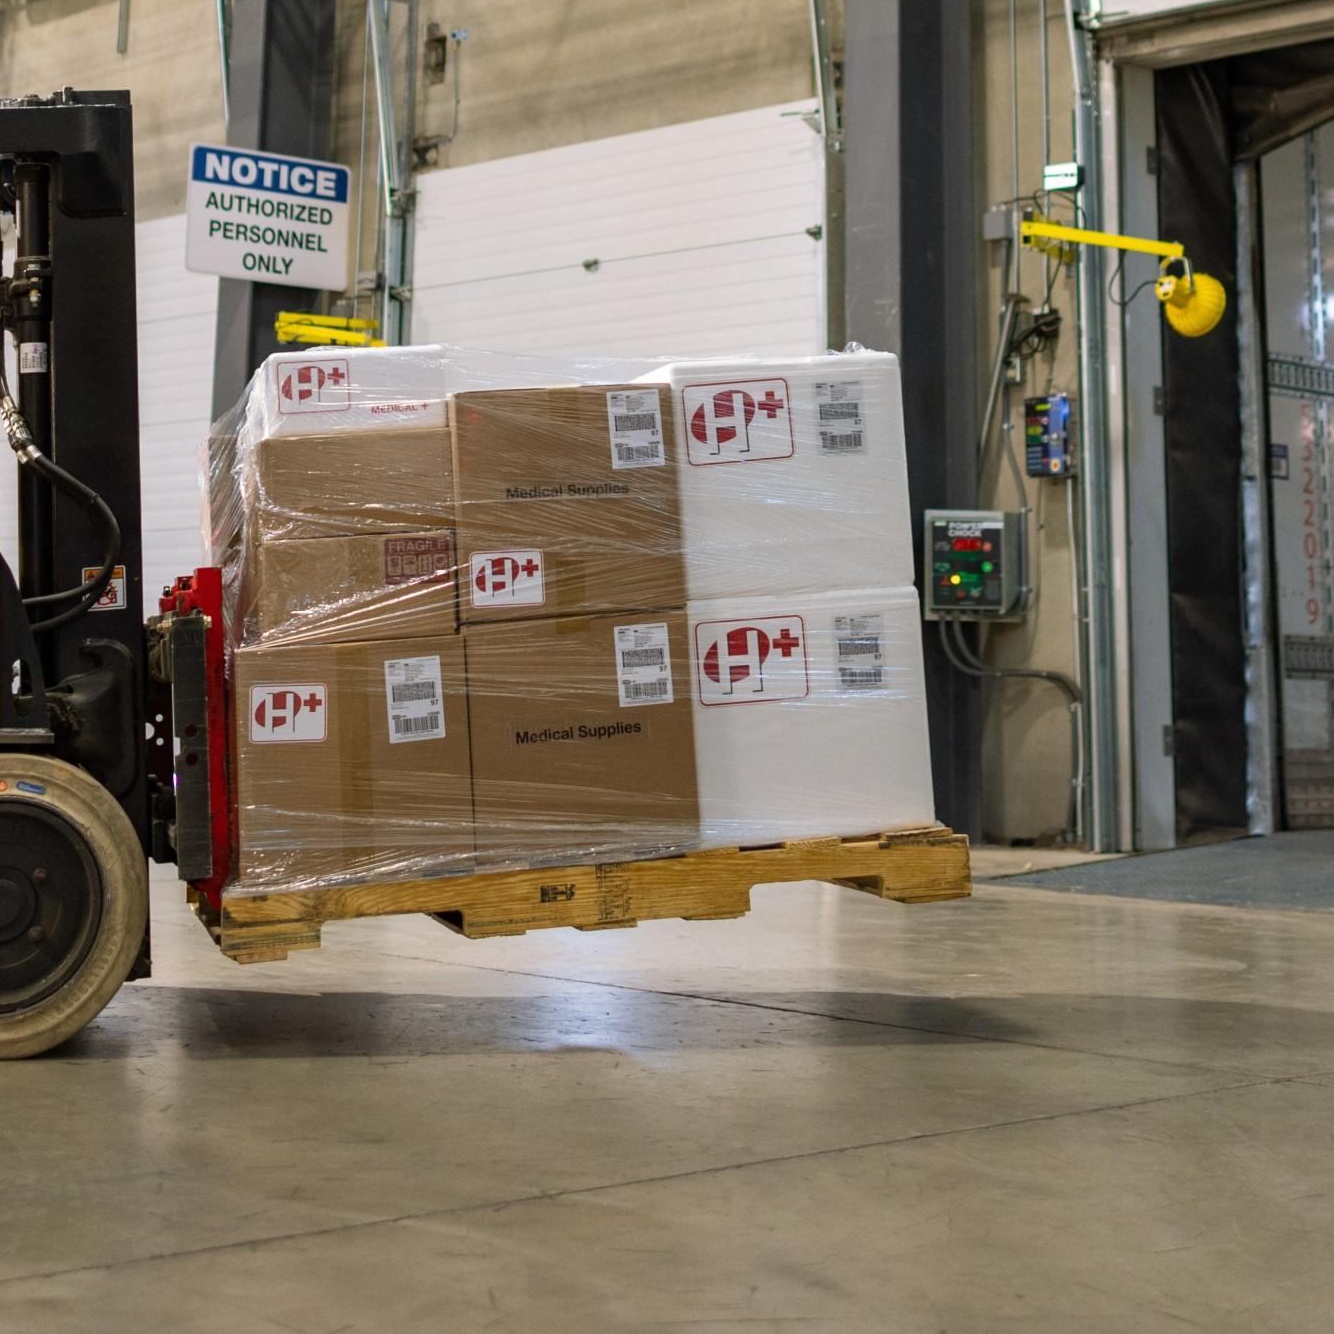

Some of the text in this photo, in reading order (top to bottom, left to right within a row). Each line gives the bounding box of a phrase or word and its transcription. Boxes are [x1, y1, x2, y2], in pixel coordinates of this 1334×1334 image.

[204, 152, 339, 198] NOTICE
[205, 191, 334, 226] AUTHORIZED
[208, 220, 328, 253] PERSONNEL
[242, 253, 294, 276] ONLY
[370, 404, 418, 415] MEDICAL
[506, 482, 630, 500] Medical Supplies
[387, 539, 446, 553] FRAGILE
[516, 720, 643, 745] Medical Supplies
